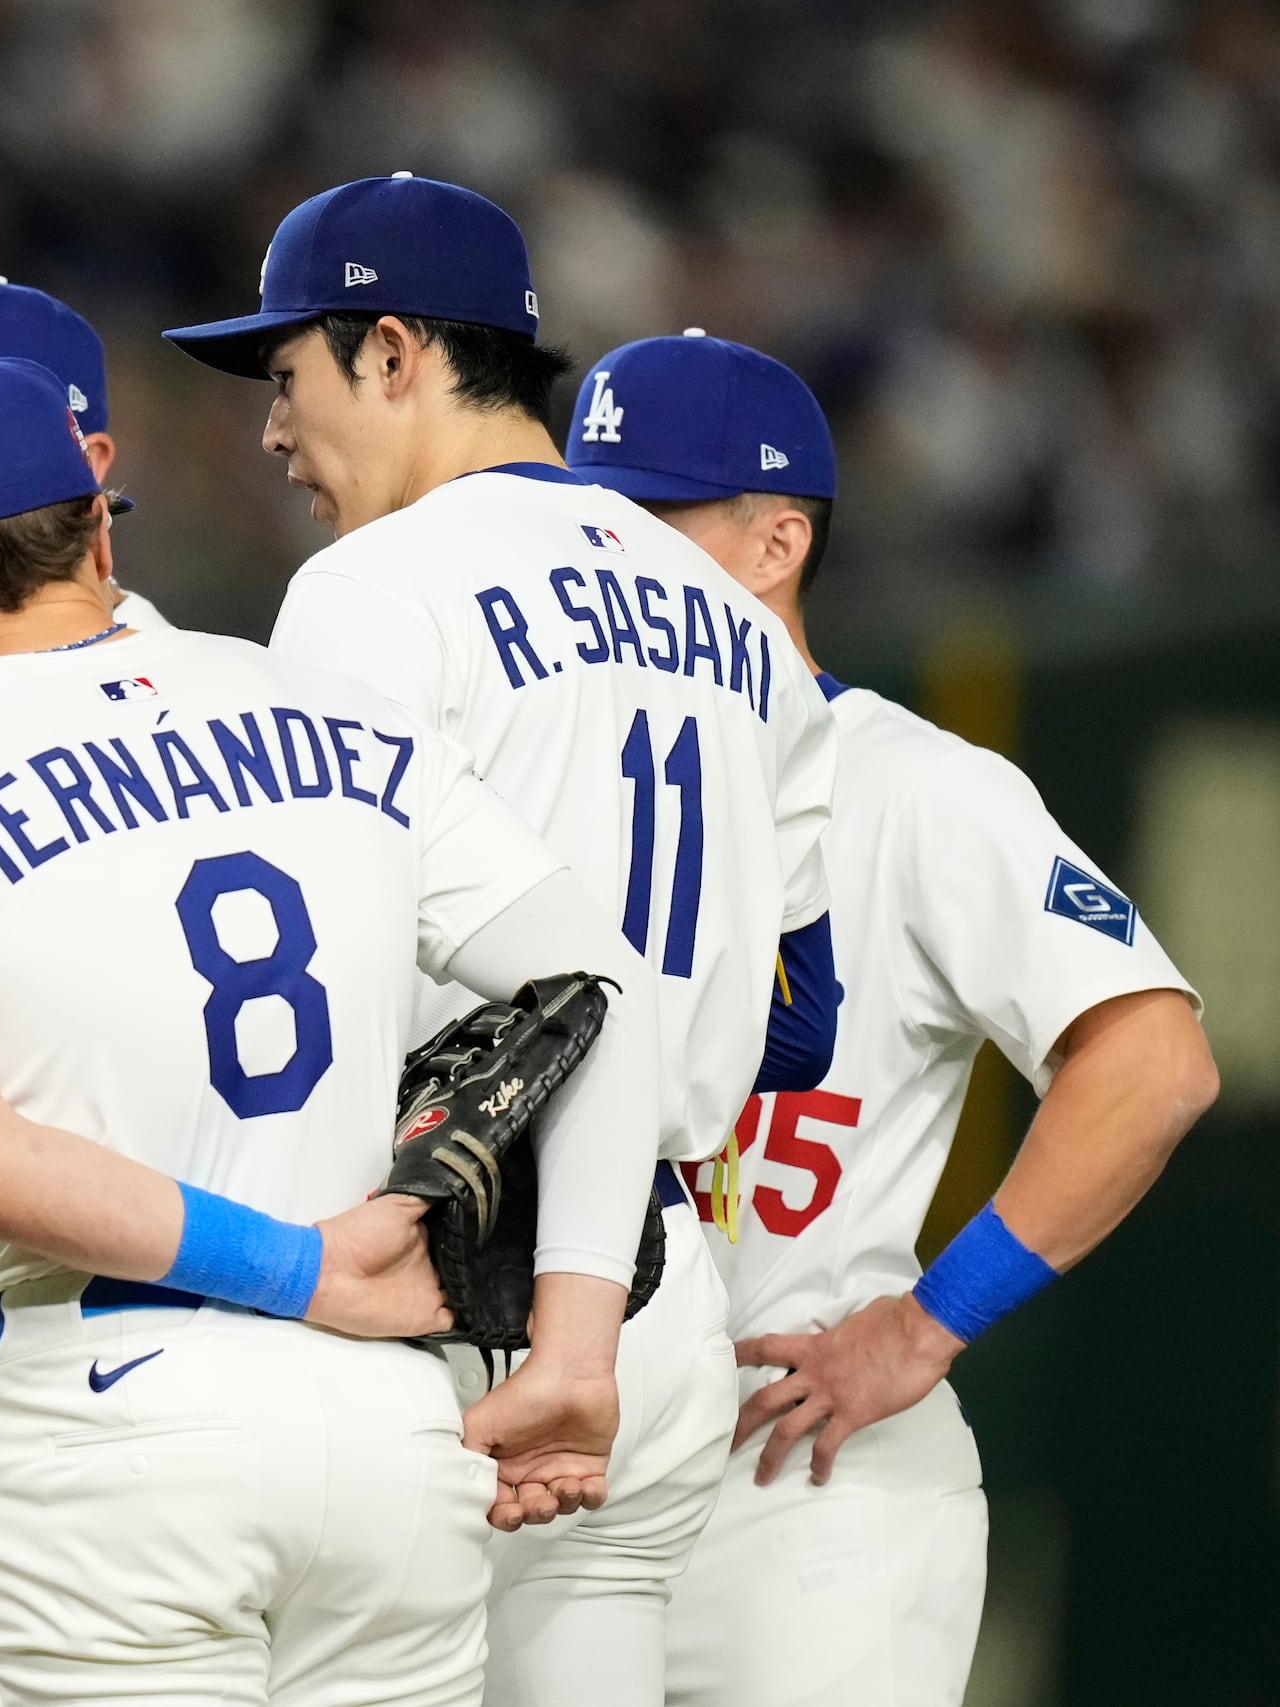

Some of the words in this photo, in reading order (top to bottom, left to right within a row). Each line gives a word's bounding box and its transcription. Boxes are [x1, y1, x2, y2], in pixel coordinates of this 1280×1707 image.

[582, 371, 624, 443] LA
[621, 708, 704, 979] 11
[1063, 883, 1111, 912] G
[175, 850, 334, 1120] 8
